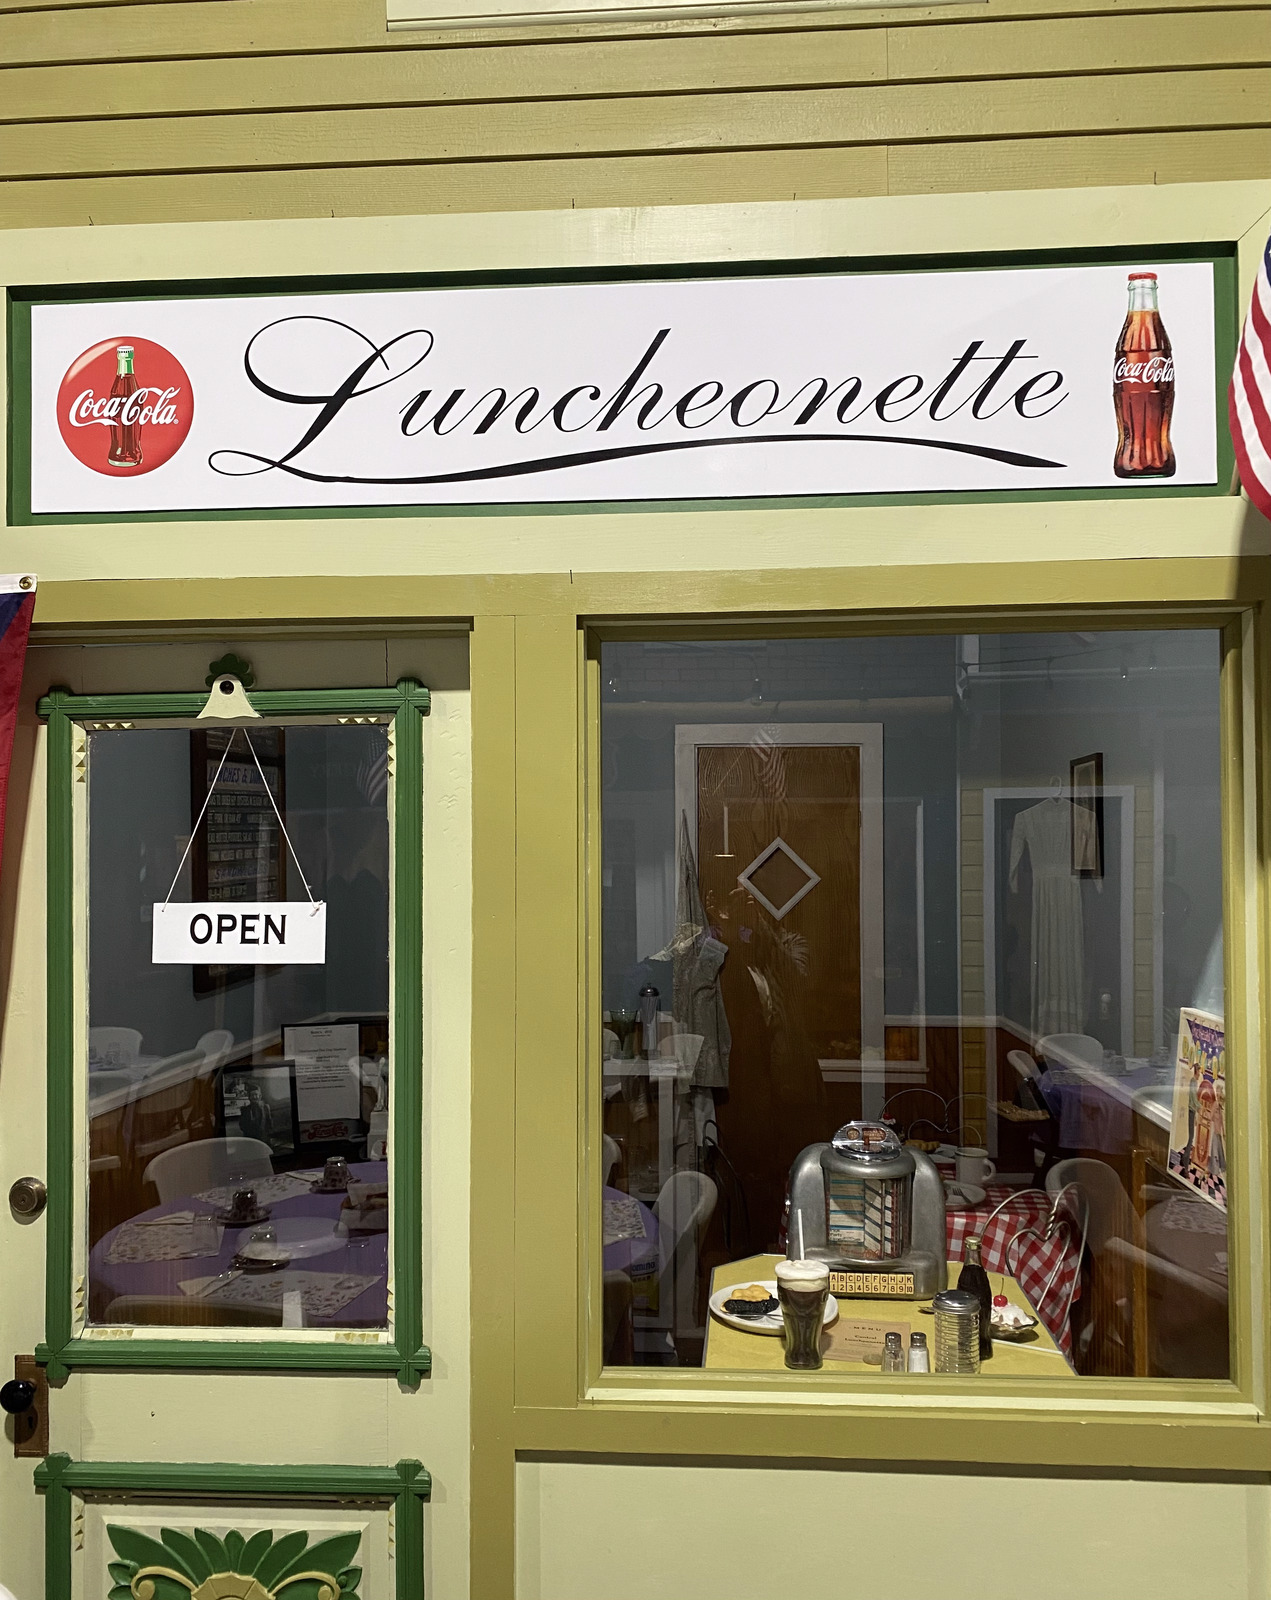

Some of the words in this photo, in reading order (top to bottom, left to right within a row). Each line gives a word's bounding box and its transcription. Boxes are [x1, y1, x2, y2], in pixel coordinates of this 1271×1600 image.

[1114, 357, 1175, 383] Coca-Cola
[69, 387, 181, 427] Coca-Cola
[208, 315, 1070, 485] Luncheonette
[190, 912, 287, 945] OPEN
